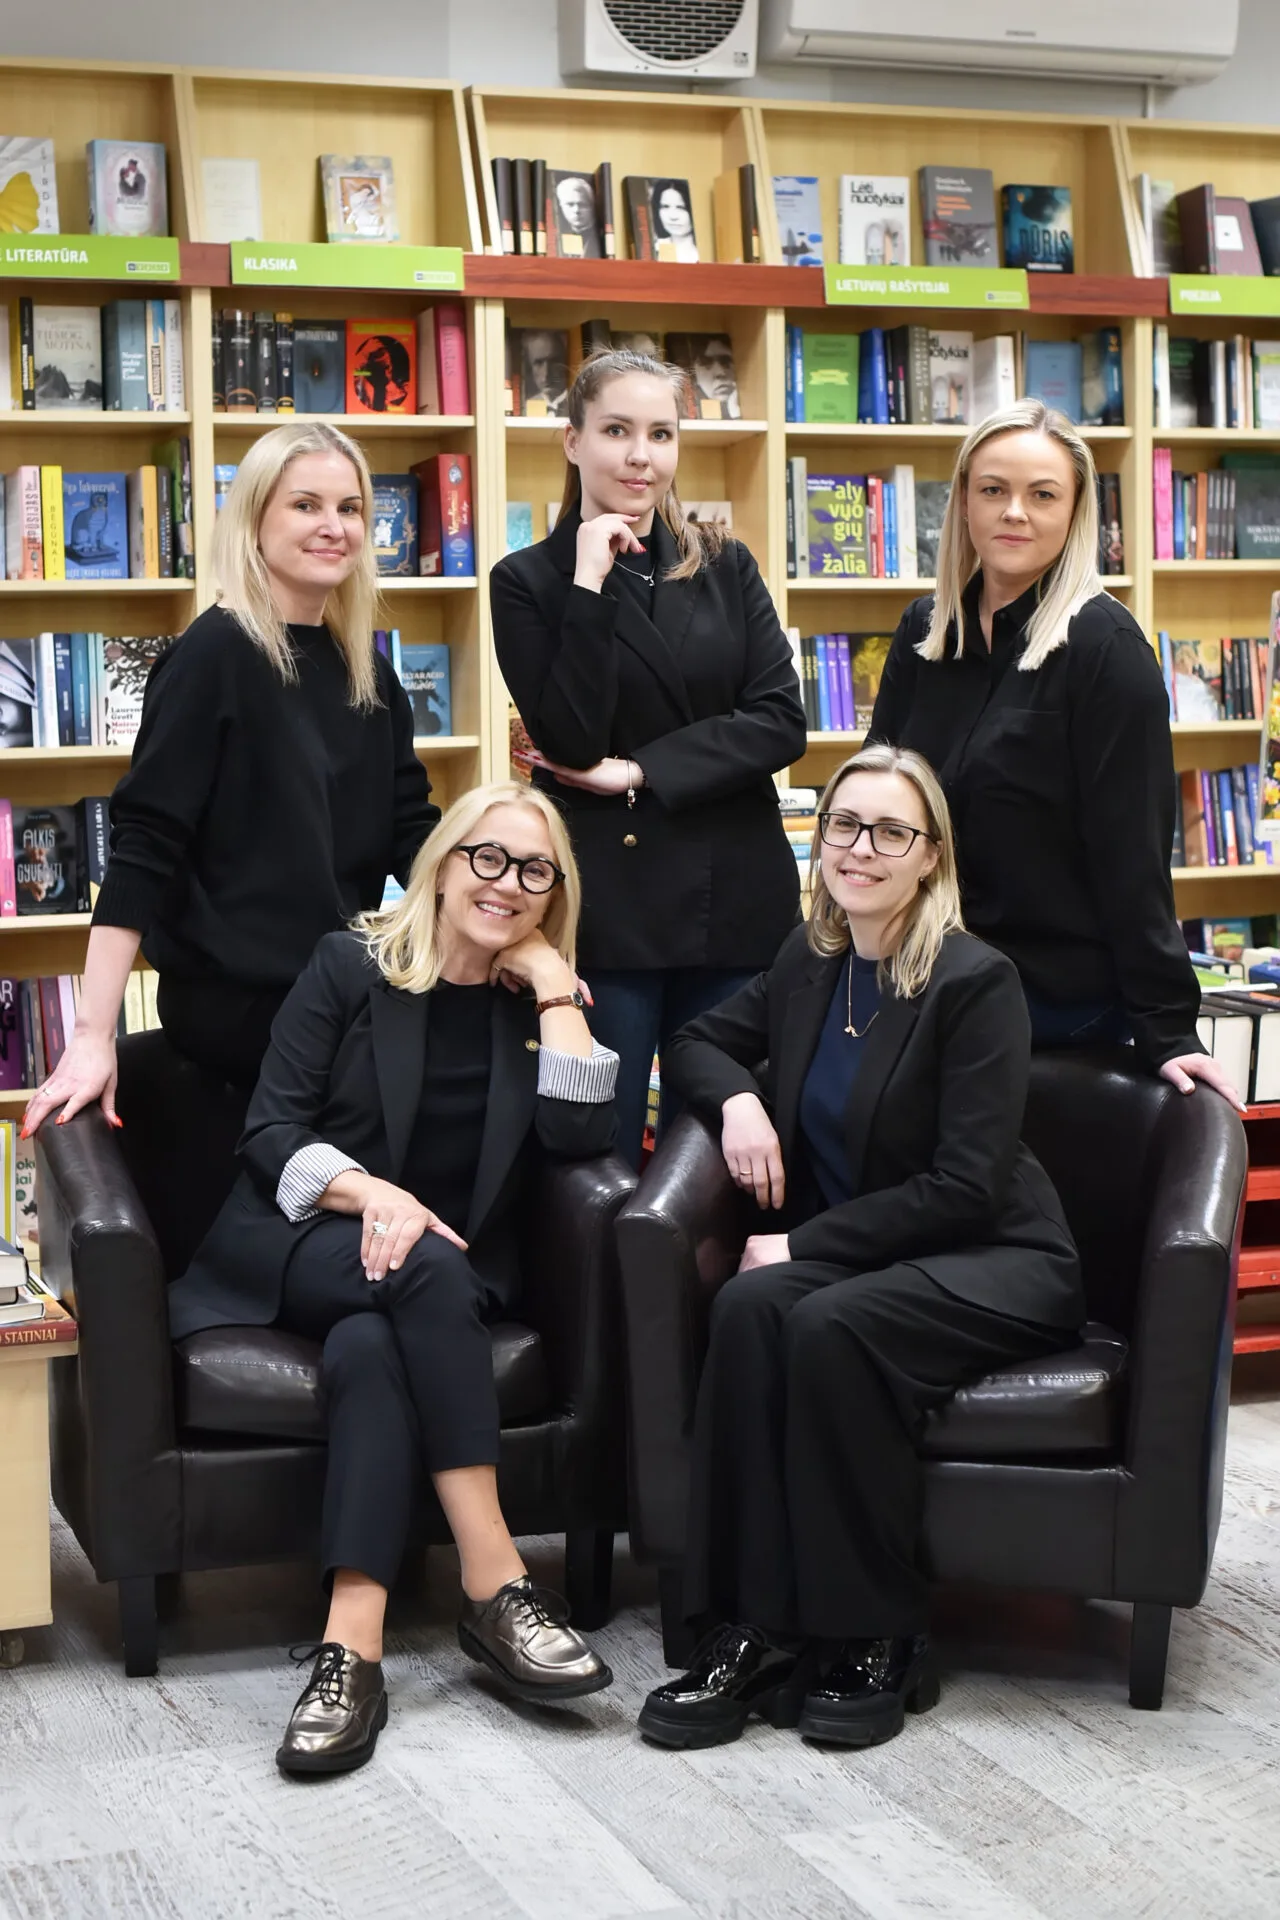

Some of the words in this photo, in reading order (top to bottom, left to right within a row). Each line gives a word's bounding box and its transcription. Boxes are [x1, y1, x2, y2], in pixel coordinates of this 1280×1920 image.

[6, 248, 88, 263] LITERATŪRA
[244, 257, 297, 271] KLASIKA
[836, 279, 886, 295] LIETUVIŲ
[889, 279, 950, 294] RAŠYTOJAI
[835, 481, 863, 505] aly
[822, 552, 867, 574] žalia
[23, 829, 55, 848] ALKIS
[17, 863, 62, 883] GYVETI
[5, 1328, 57, 1344] STATINIAI
